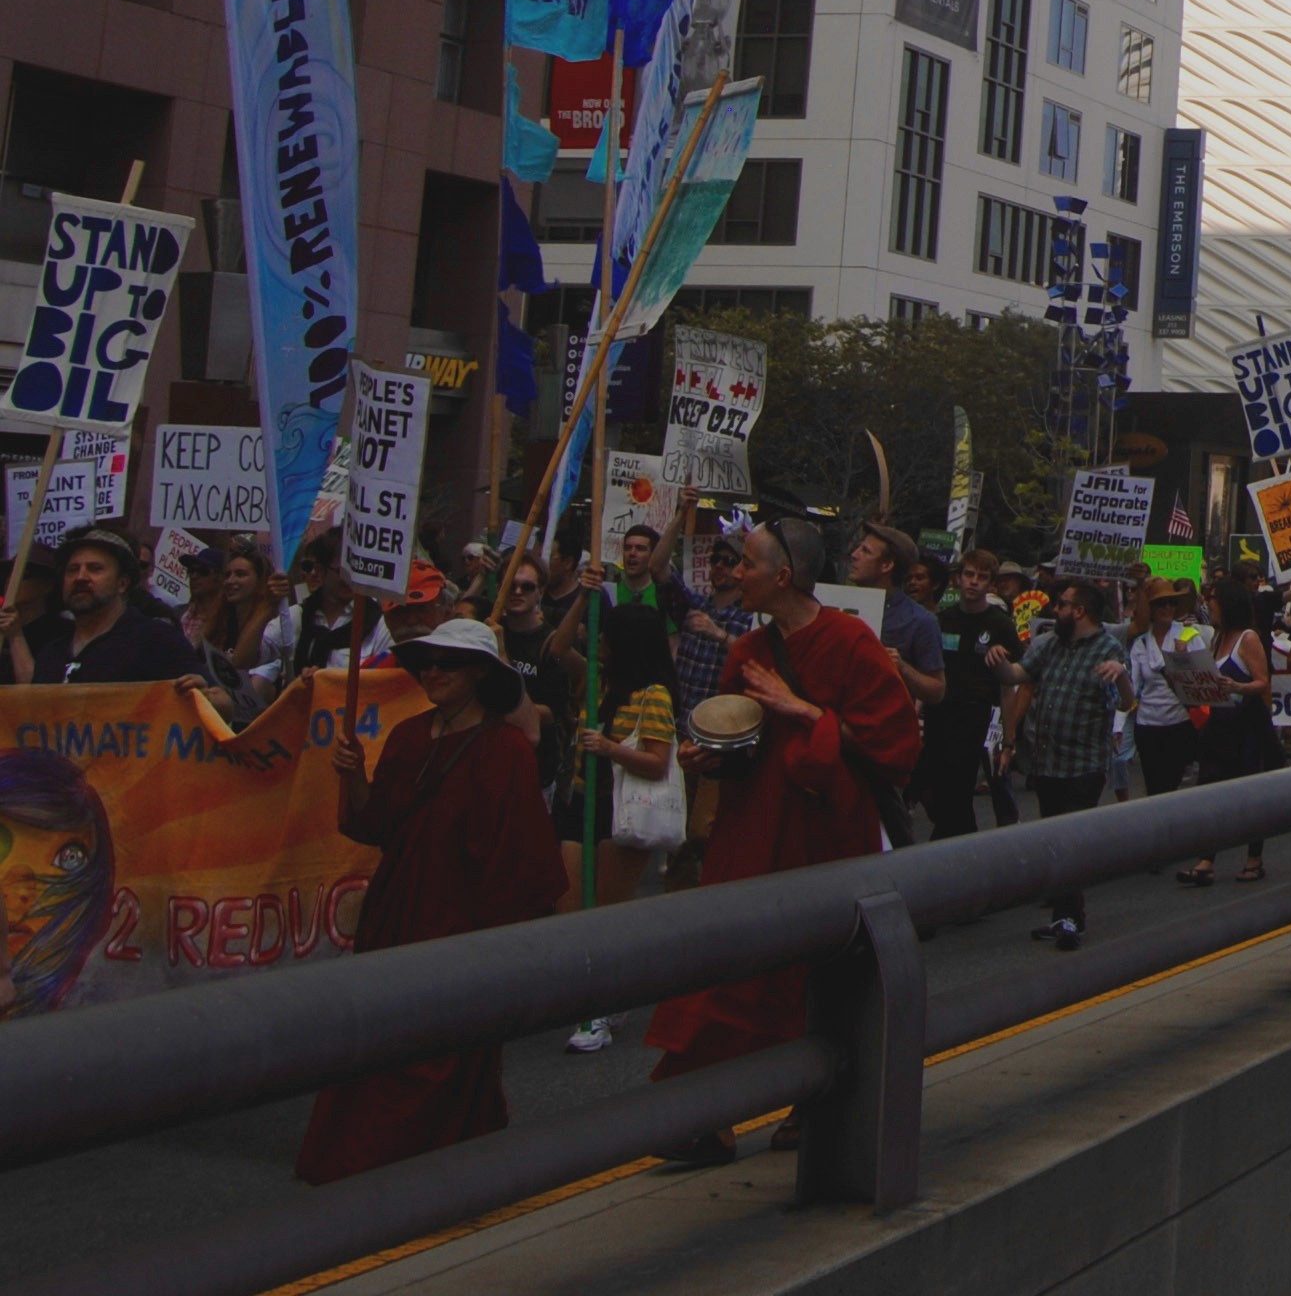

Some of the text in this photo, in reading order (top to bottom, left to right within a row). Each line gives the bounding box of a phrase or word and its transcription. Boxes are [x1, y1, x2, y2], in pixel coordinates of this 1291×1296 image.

[558, 110, 625, 129] THE BROD
[1170, 165, 1187, 275] THE EMERSON
[49, 212, 180, 275] STAND
[43, 260, 166, 321] UP TO
[25, 306, 149, 370] BIG
[302, 270, 349, 407] 100%
[405, 353, 479, 389] BWAY
[11, 361, 129, 422] OIL
[1239, 373, 1280, 402] UP
[670, 396, 749, 441] KEEP OIL
[73, 440, 117, 459] CHANGE
[161, 432, 221, 470] KEEP
[358, 436, 395, 471] NOT
[13, 469, 39, 480] FROM
[1081, 476, 1146, 495] JAIL for
[17, 492, 30, 501] TO
[160, 482, 202, 521] TAX
[378, 490, 407, 520] ST.
[1074, 490, 1148, 512] Corporate
[1072, 506, 1145, 527] Polluters!
[169, 530, 200, 554] PEOPLE
[1062, 545, 1072, 554] is
[1065, 529, 1142, 548] capitalism
[159, 554, 189, 580] PLANE
[1157, 562, 1188, 572] LIVES
[156, 574, 181, 596] OVER
[17, 722, 152, 758] CLIMATE
[105, 886, 143, 962] 2
